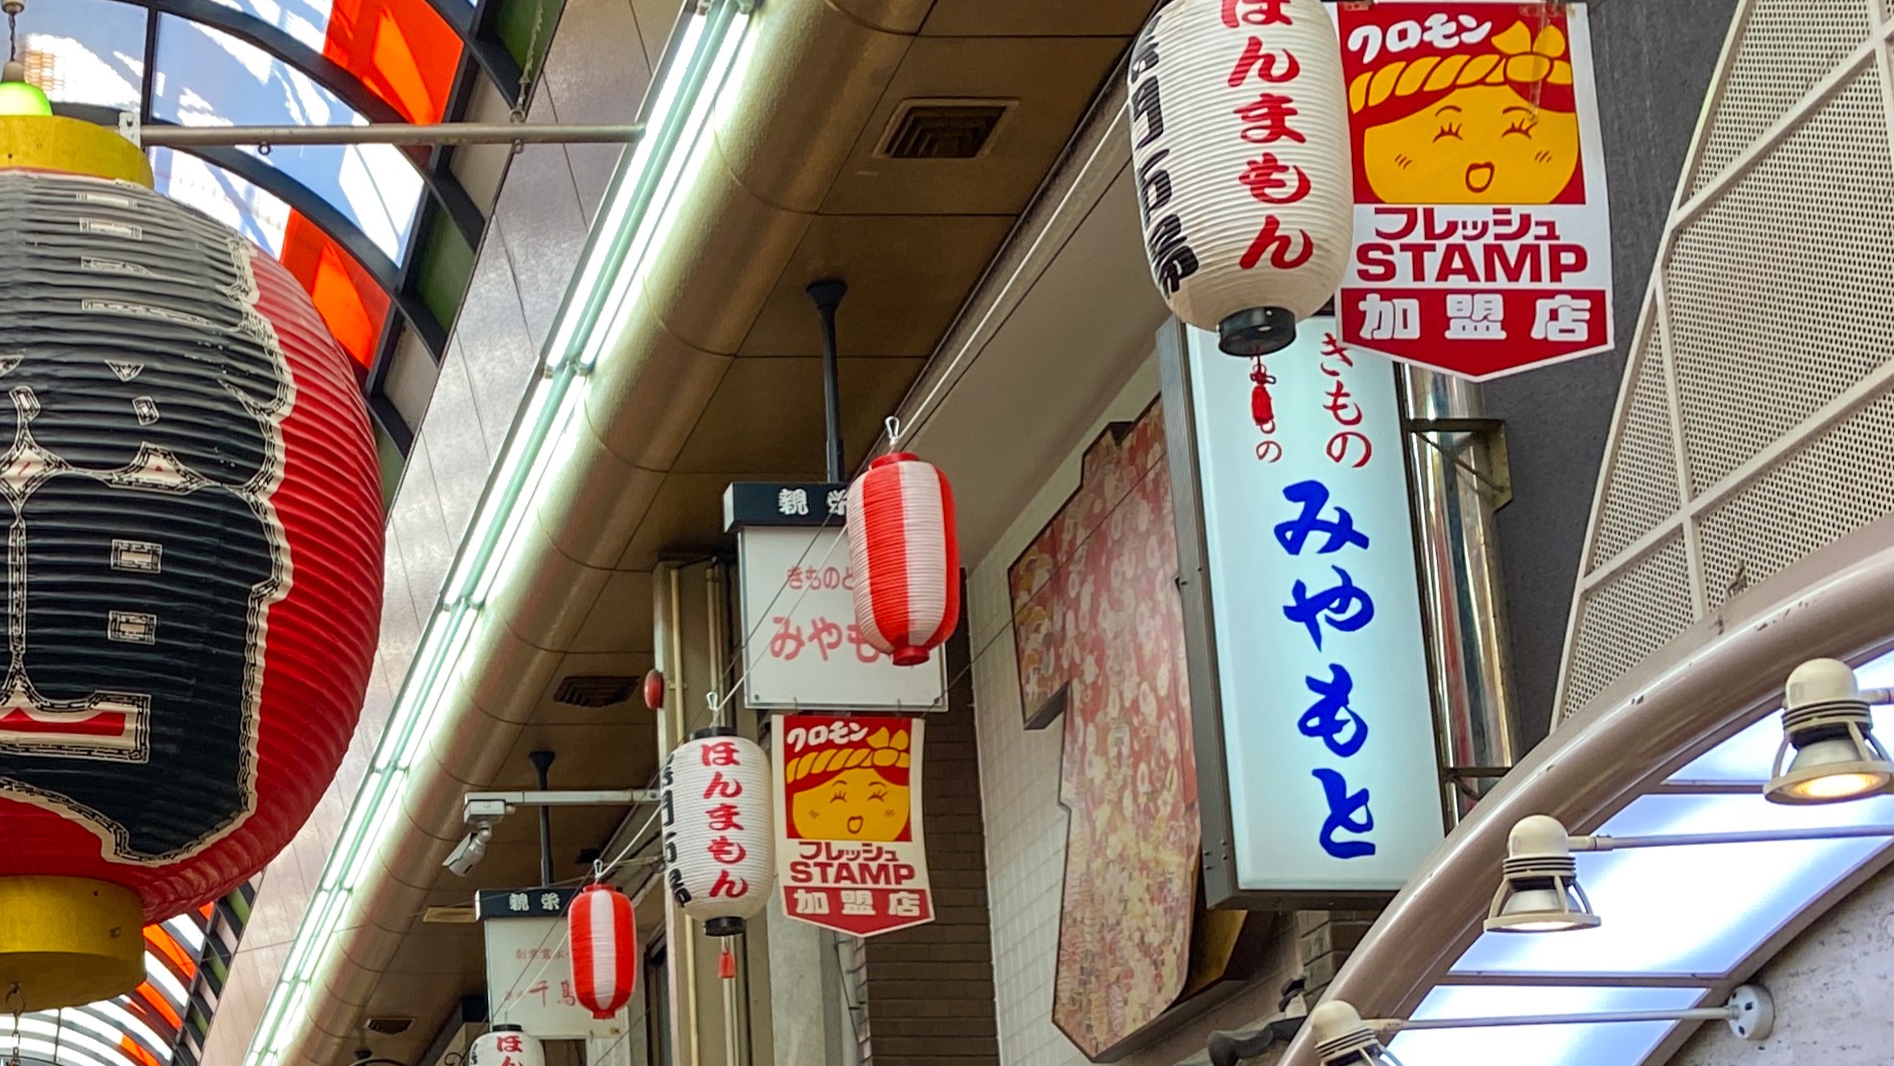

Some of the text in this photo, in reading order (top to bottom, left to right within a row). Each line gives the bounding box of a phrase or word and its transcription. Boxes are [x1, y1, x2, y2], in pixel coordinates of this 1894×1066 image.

[1347, 13, 1493, 63] クロモン
[1373, 207, 1561, 242] フレッシュ
[1355, 243, 1588, 284] STAMP
[1358, 292, 1591, 342] 加盟店
[1319, 332, 1372, 468] きもの
[778, 488, 848, 516] 親栄
[768, 615, 886, 665] みやも
[1273, 478, 1377, 860] みやもと
[786, 719, 868, 751] クロモン
[700, 741, 749, 899] ほんまもん
[798, 841, 899, 862] フレッシュ
[789, 862, 915, 887] STAMP
[508, 892, 560, 911] 親栄
[793, 889, 923, 918] 加盟店
